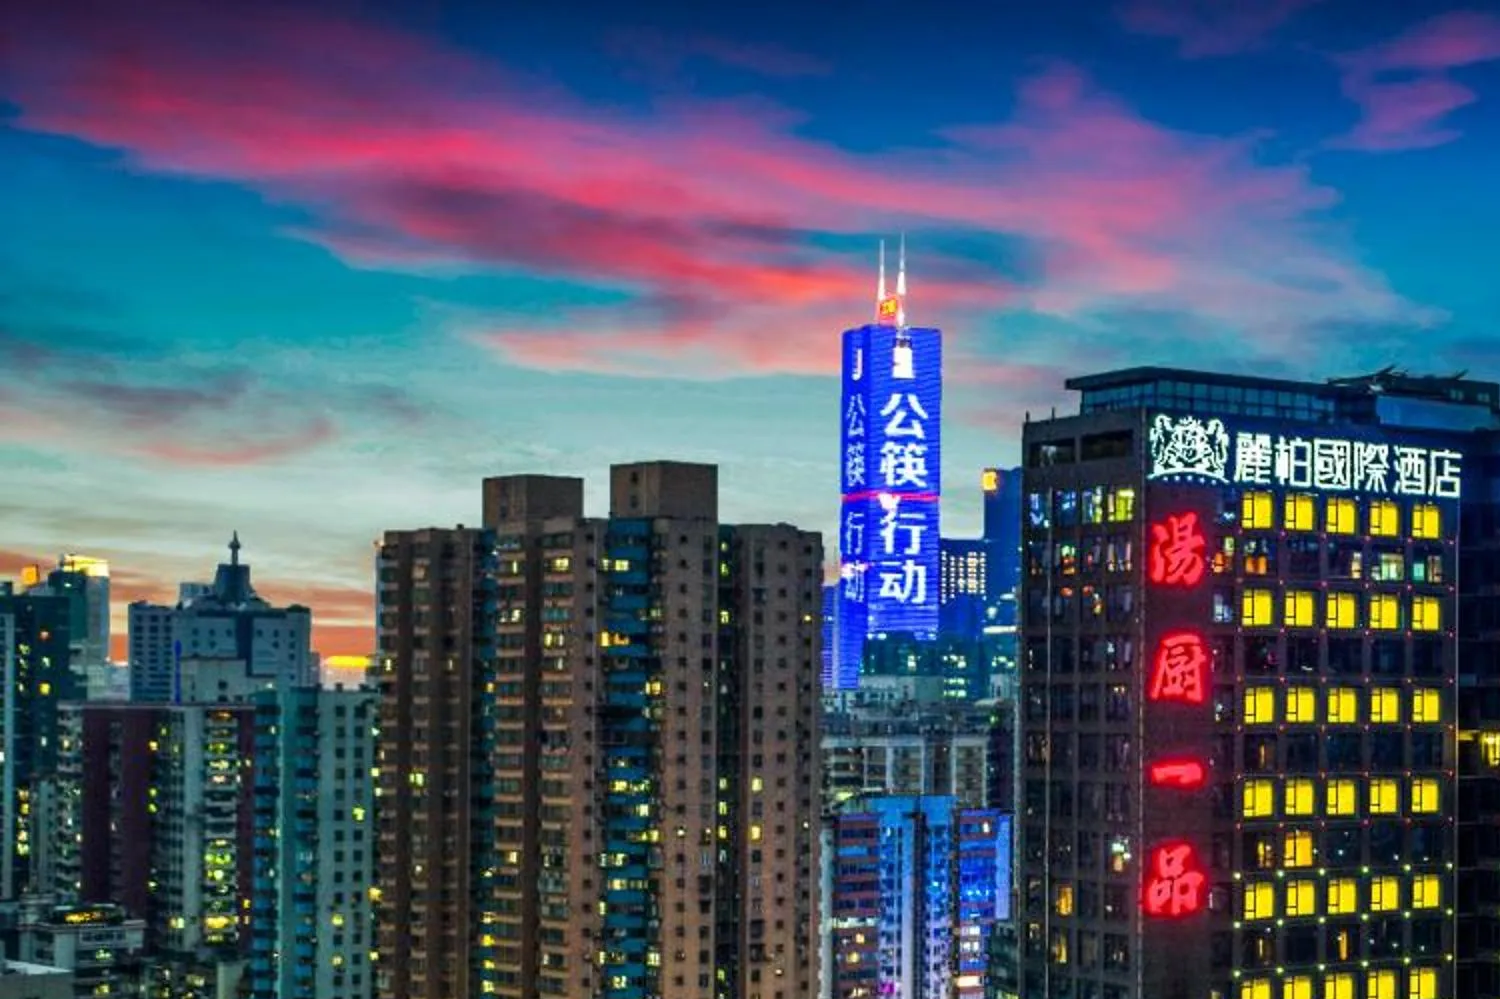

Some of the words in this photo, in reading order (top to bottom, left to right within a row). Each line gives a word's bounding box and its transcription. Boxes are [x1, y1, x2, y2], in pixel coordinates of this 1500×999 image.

[880, 393, 928, 604] 公筷行动
[1233, 430, 1464, 498] 麗柏國際酒店
